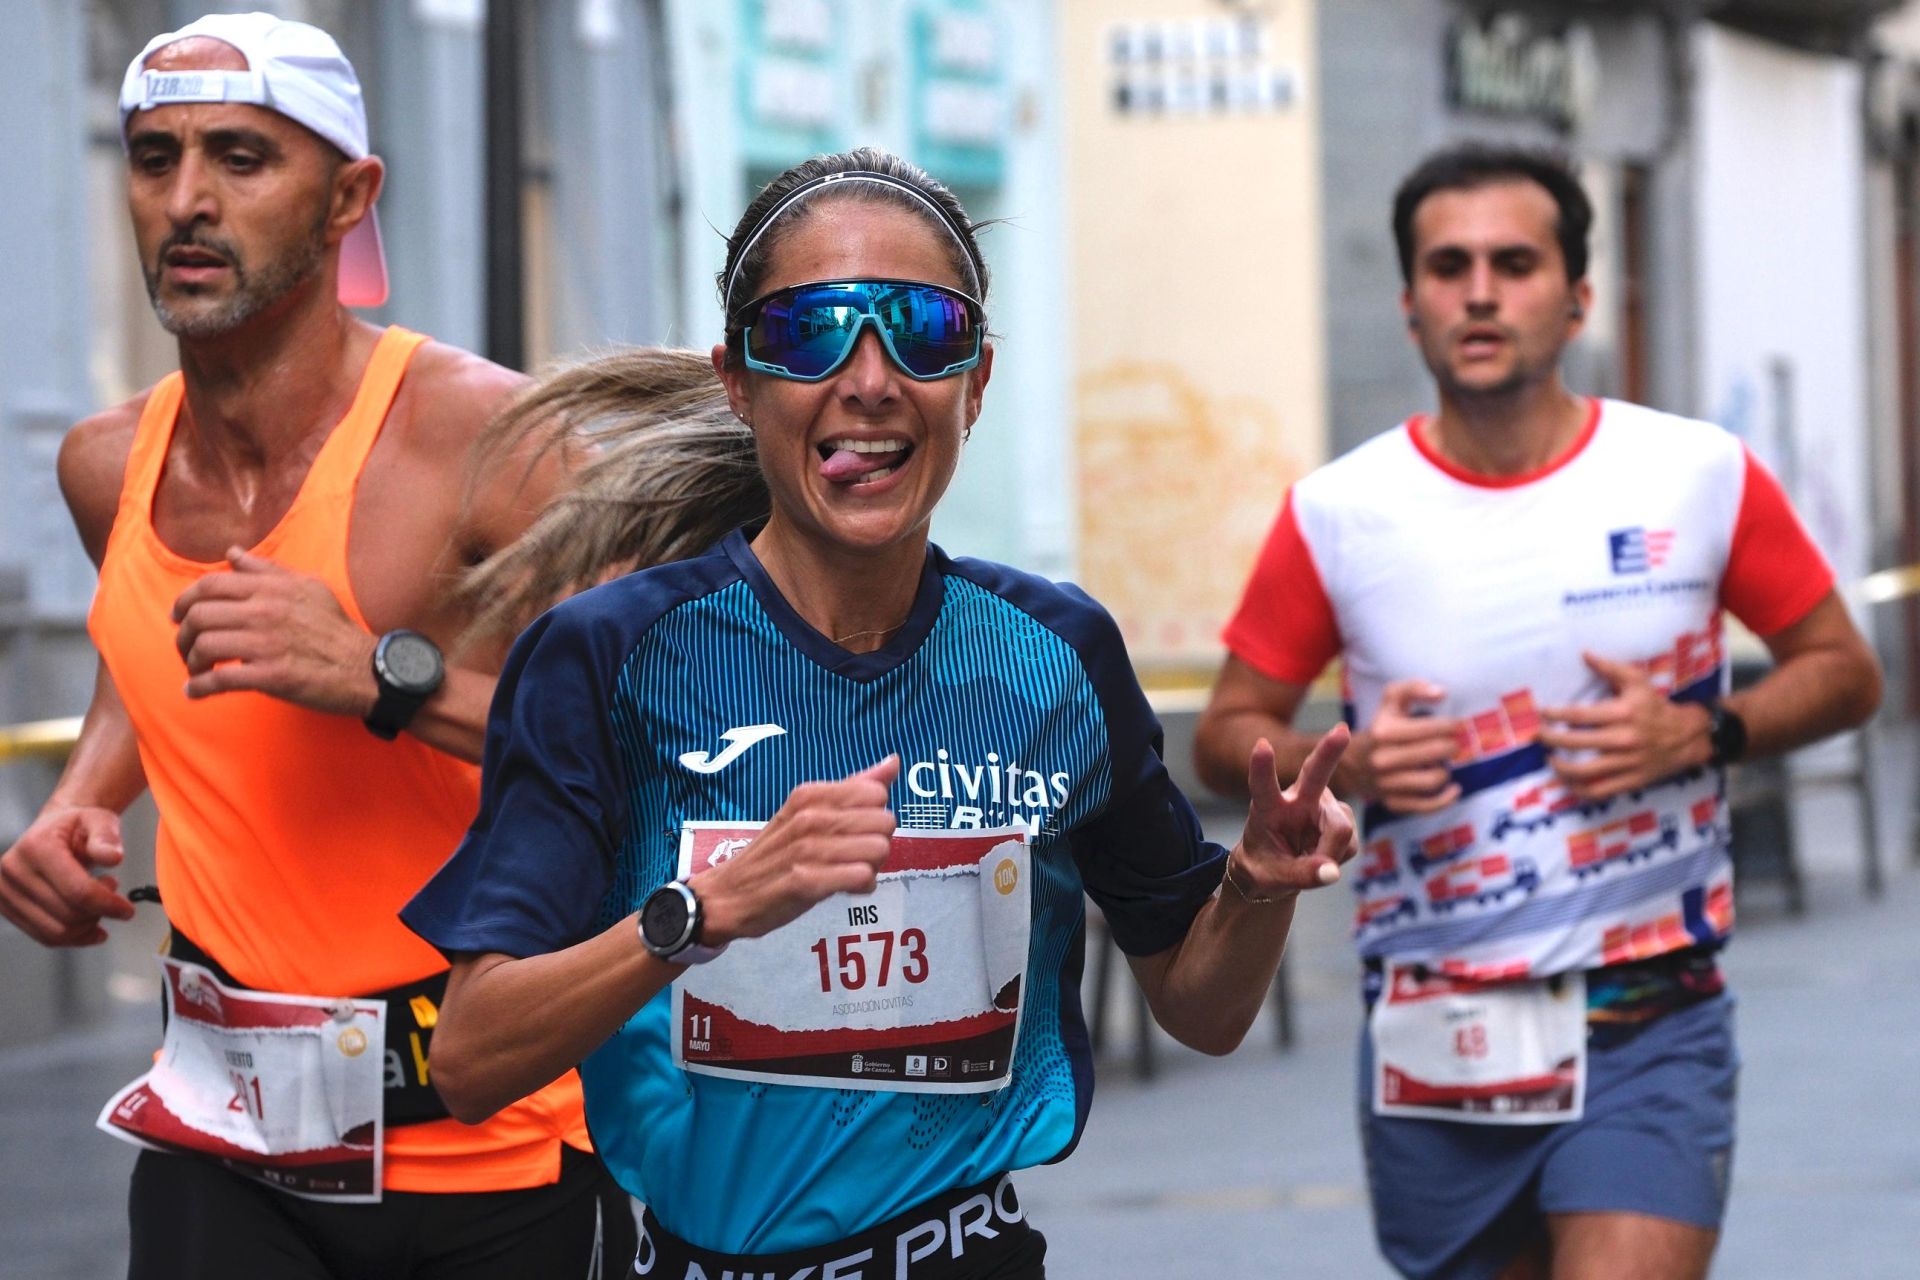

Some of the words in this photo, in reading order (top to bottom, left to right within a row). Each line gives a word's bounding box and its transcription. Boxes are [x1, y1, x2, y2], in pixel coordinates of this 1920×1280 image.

[908, 749, 1069, 809] civitas
[998, 865, 1015, 888] 10K
[848, 905, 878, 926] IRIS
[811, 928, 929, 992] 1573
[690, 1014, 711, 1040] 11
[689, 1040, 710, 1051] MAYO
[896, 1173, 1023, 1280] PRO
